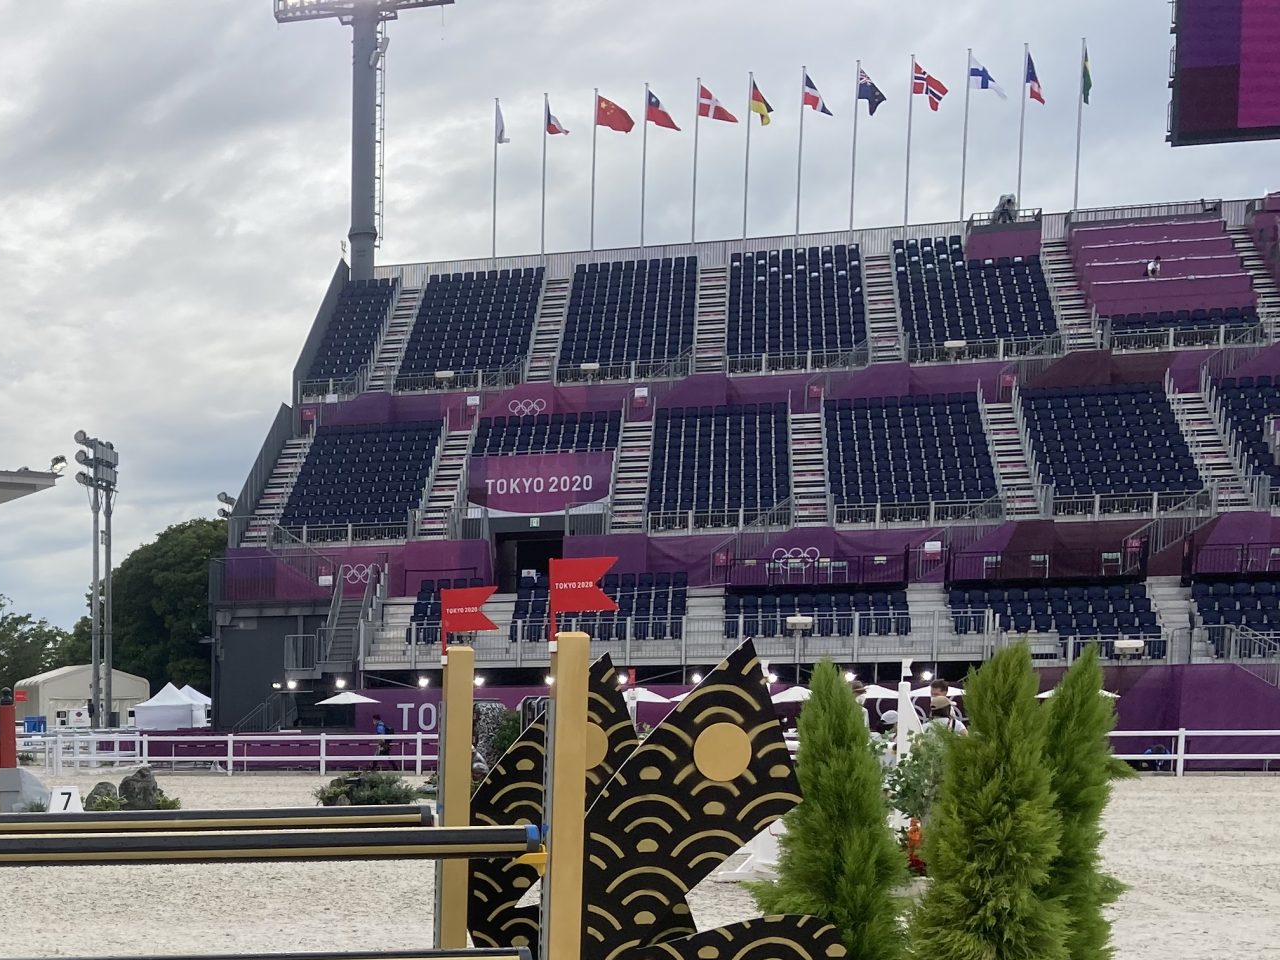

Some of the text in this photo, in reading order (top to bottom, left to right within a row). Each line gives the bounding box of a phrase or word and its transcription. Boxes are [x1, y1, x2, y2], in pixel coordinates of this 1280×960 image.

[485, 475, 593, 495] TOKYO 2020
[577, 581, 593, 589] 2020
[396, 702, 437, 731] TO
[60, 791, 72, 811] 7
